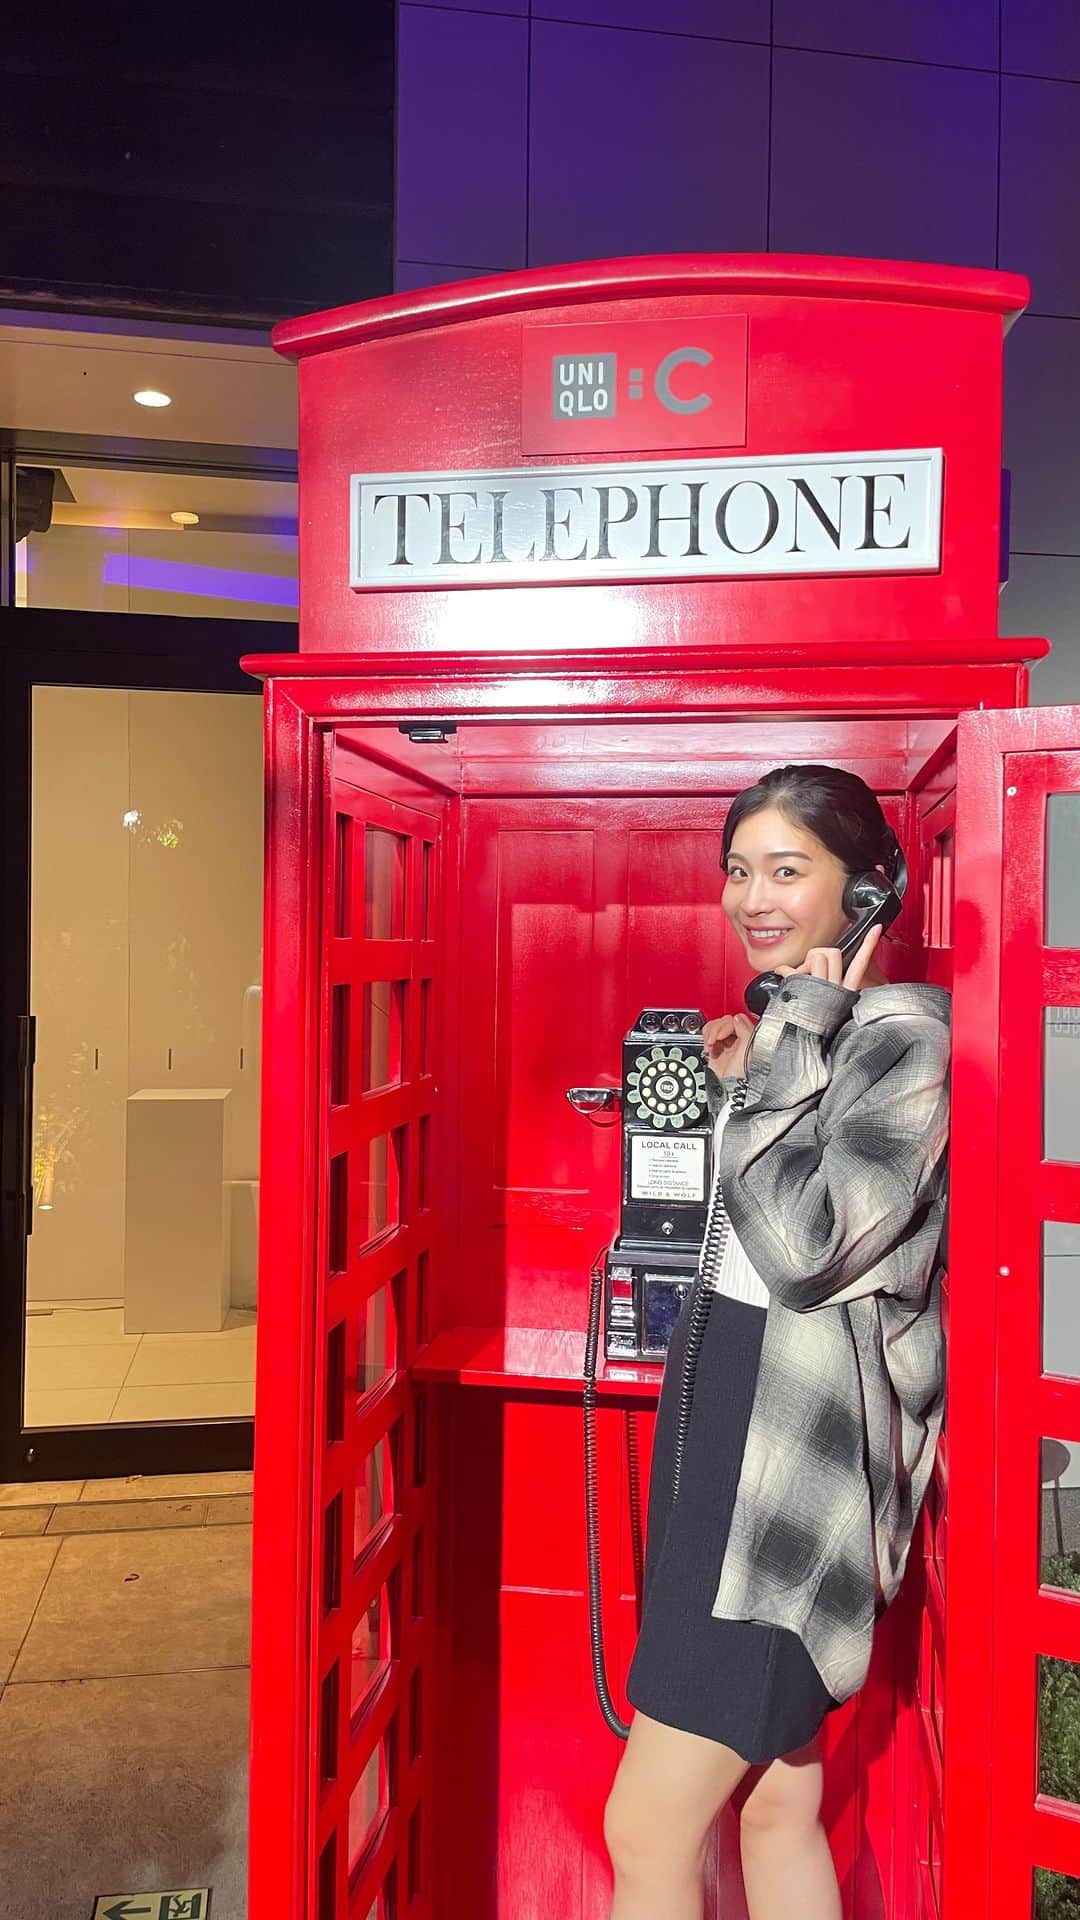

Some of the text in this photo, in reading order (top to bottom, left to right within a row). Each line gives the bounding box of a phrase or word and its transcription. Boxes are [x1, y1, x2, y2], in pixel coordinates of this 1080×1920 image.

[559, 362, 604, 386] UNI
[559, 388, 608, 416] QLO
[373, 473, 911, 567] TELEPHONE
[641, 1141, 697, 1150] LOCAL CALL
